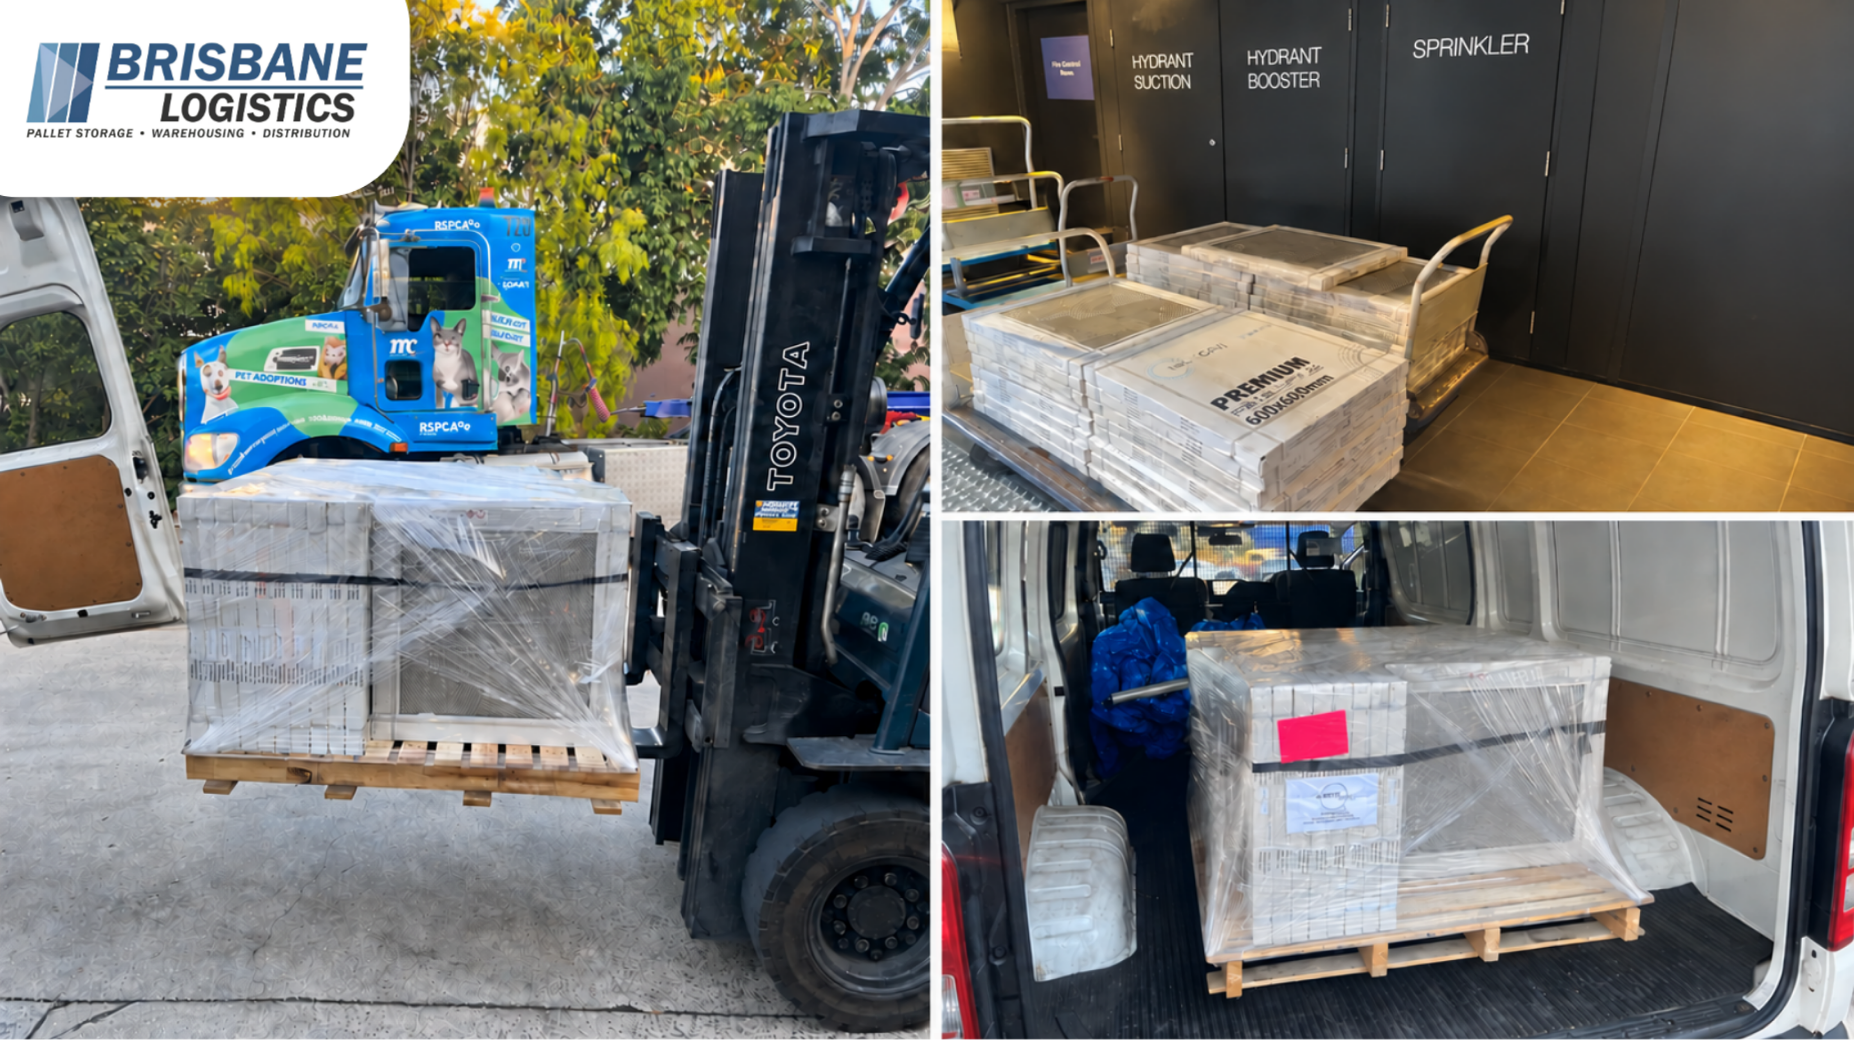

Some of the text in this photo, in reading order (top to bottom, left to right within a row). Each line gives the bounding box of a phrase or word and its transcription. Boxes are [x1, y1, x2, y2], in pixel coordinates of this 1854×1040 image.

[1247, 46, 1323, 66] HYDRANT
[1412, 33, 1530, 59] SPRINKLER
[1131, 52, 1194, 70] HYDRANT
[1133, 73, 1192, 90] SUCTION
[1247, 70, 1321, 90] BOOSTER
[235, 371, 251, 380] PET
[1210, 356, 1311, 411] PREMIUM
[766, 341, 810, 492] TOYOTA
[419, 421, 459, 433] RSPCA
